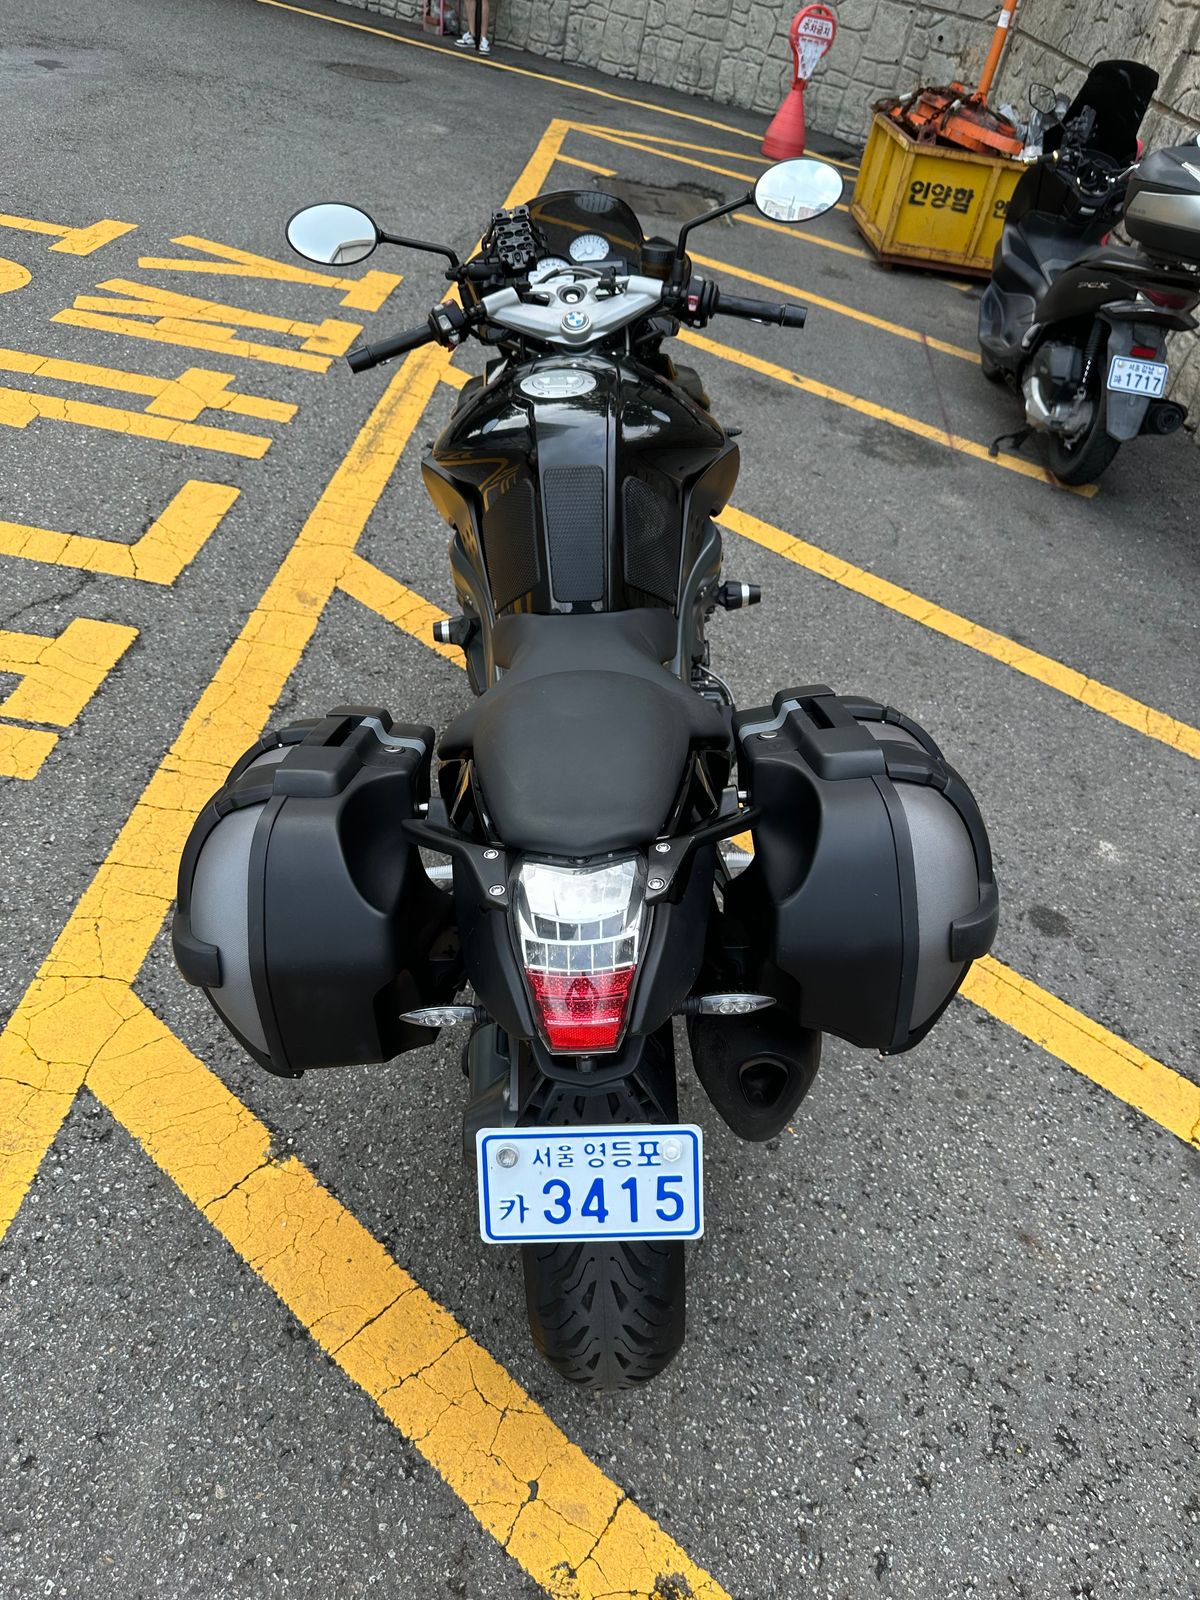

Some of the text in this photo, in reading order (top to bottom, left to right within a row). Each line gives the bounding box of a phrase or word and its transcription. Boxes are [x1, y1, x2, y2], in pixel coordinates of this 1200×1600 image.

[803, 22, 831, 37] 주차금지
[909, 180, 975, 214] 인양함
[1129, 363, 1140, 372] 서울
[1126, 372, 1161, 392] 1717
[533, 1141, 662, 1168] 서울 영등포
[499, 1175, 685, 1225] 카 3415
